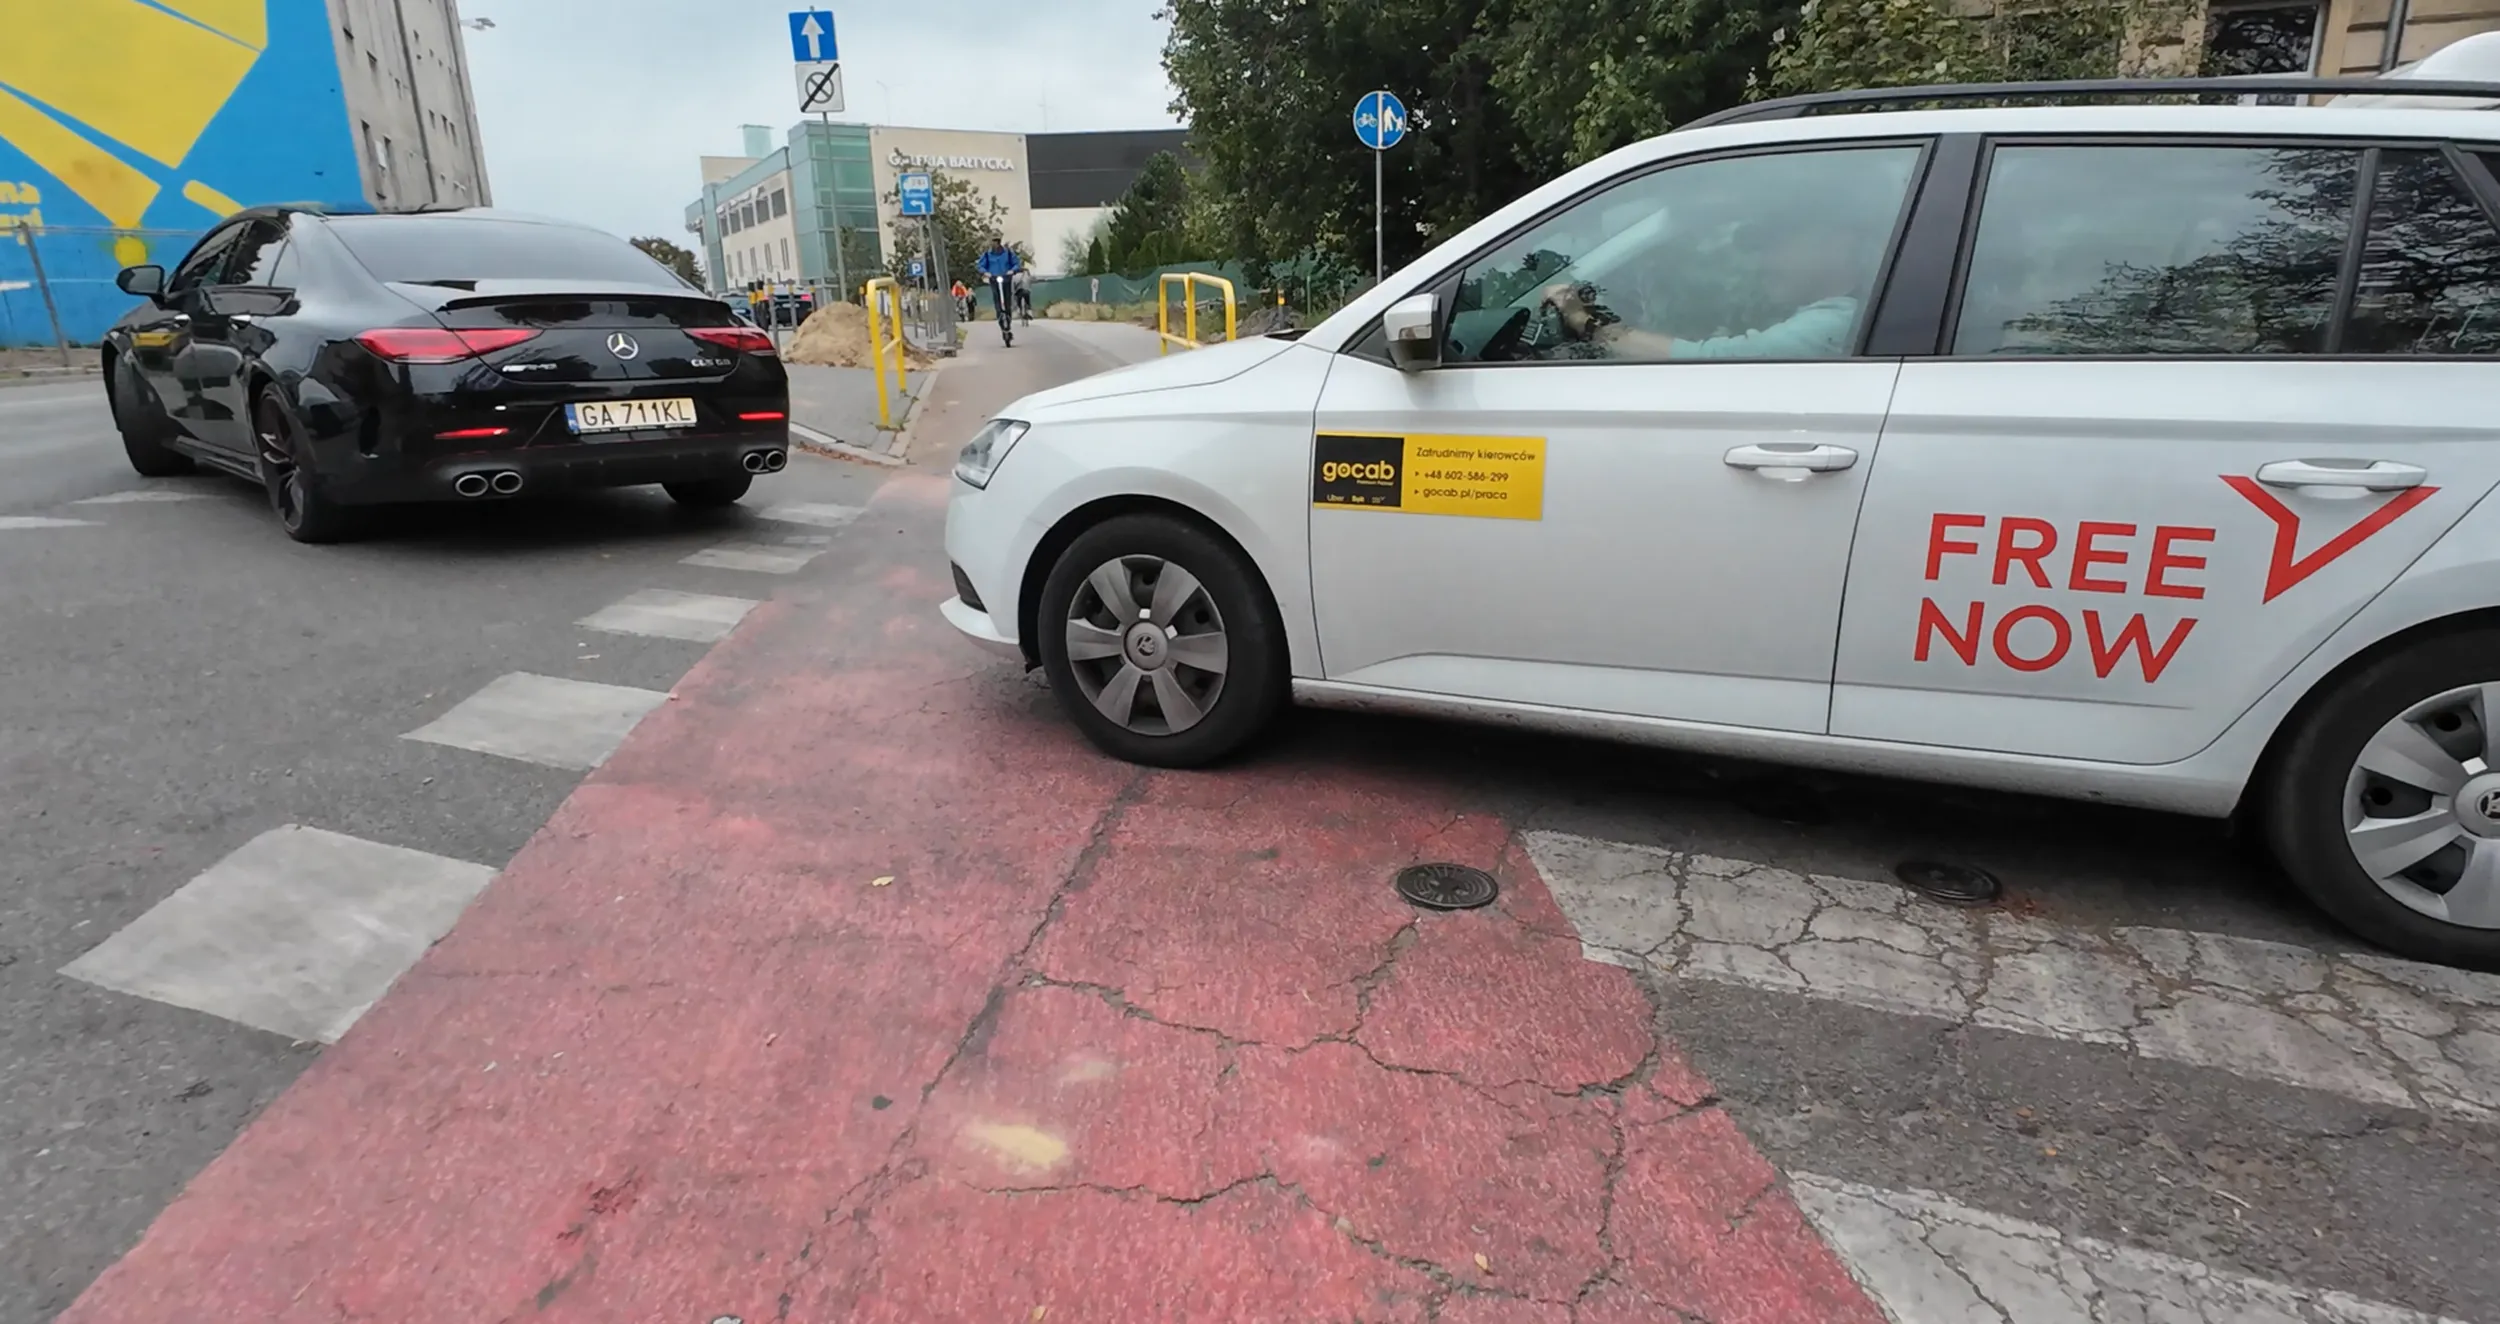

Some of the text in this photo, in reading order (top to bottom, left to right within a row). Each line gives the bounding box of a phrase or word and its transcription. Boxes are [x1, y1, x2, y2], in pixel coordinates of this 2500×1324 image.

[949, 155, 1014, 171] BAŁTYCKA
[582, 400, 691, 427] GA 711KL
[1416, 447, 1536, 462] Zatrudnimy kierowców
[1322, 459, 1395, 482] gocab
[1424, 470, 1510, 483] +48 602-586-299
[1423, 488, 1508, 501] gocab.pl/praca
[1924, 512, 2216, 600] FREE
[1913, 596, 2199, 685] NOW
